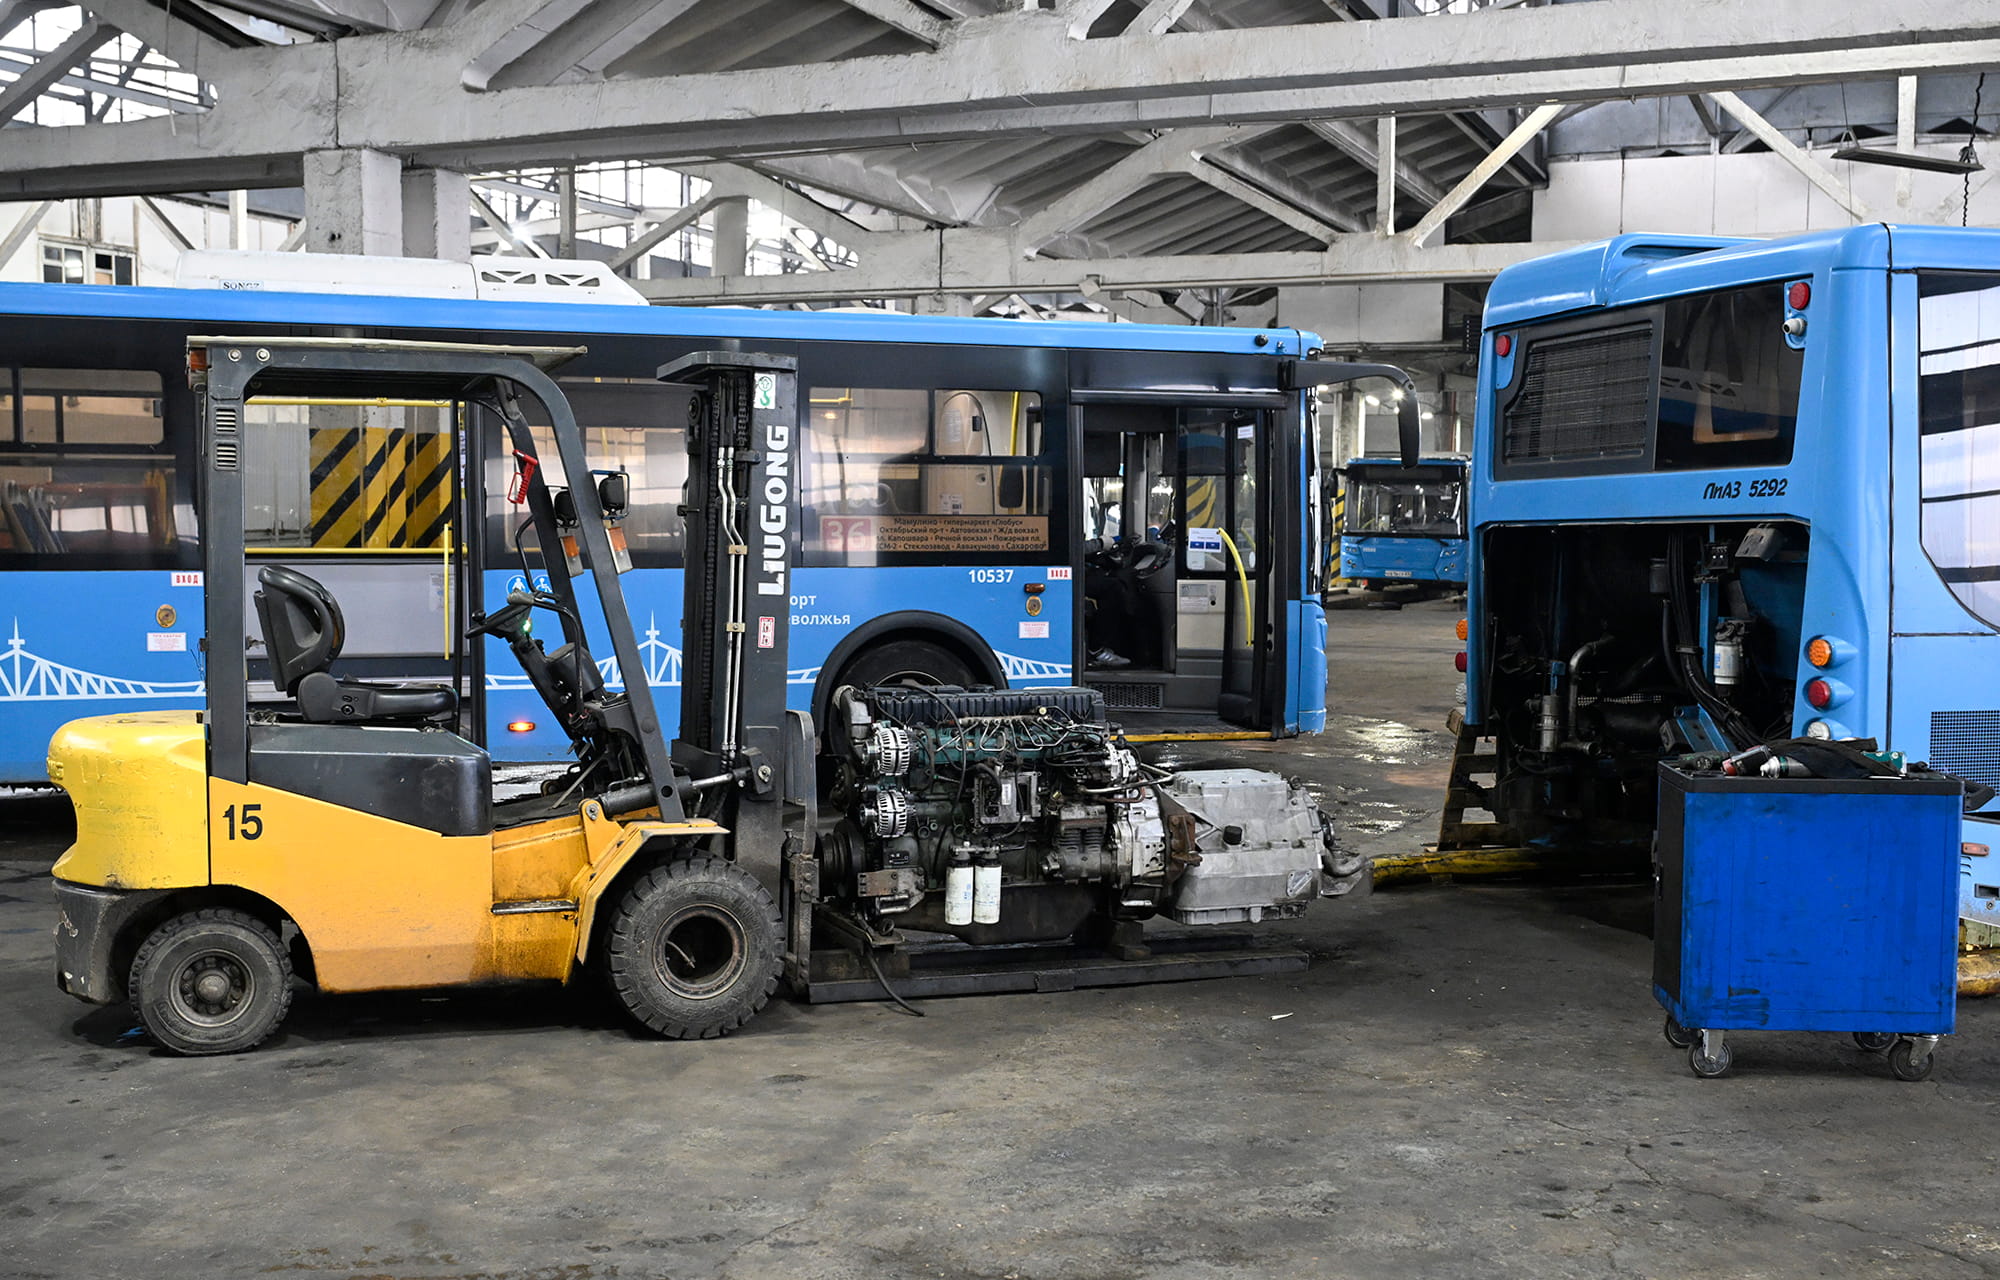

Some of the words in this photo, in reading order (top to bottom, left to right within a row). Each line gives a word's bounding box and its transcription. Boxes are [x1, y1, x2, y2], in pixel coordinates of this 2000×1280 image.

[1748, 478, 1788, 498] 5292
[758, 425, 789, 595] LIUGONG
[880, 526, 927, 534] Октябрьский
[894, 518, 938, 528] Мамулино
[943, 519, 990, 527] гипермаркет
[827, 520, 867, 550] 36
[935, 534, 962, 542] Речной
[993, 535, 1029, 543] Пожарная
[903, 542, 951, 551] Стеклозавод
[968, 569, 1014, 584] 10537
[789, 595, 817, 610] орт
[788, 614, 851, 626] волжья
[222, 804, 263, 841] 15
